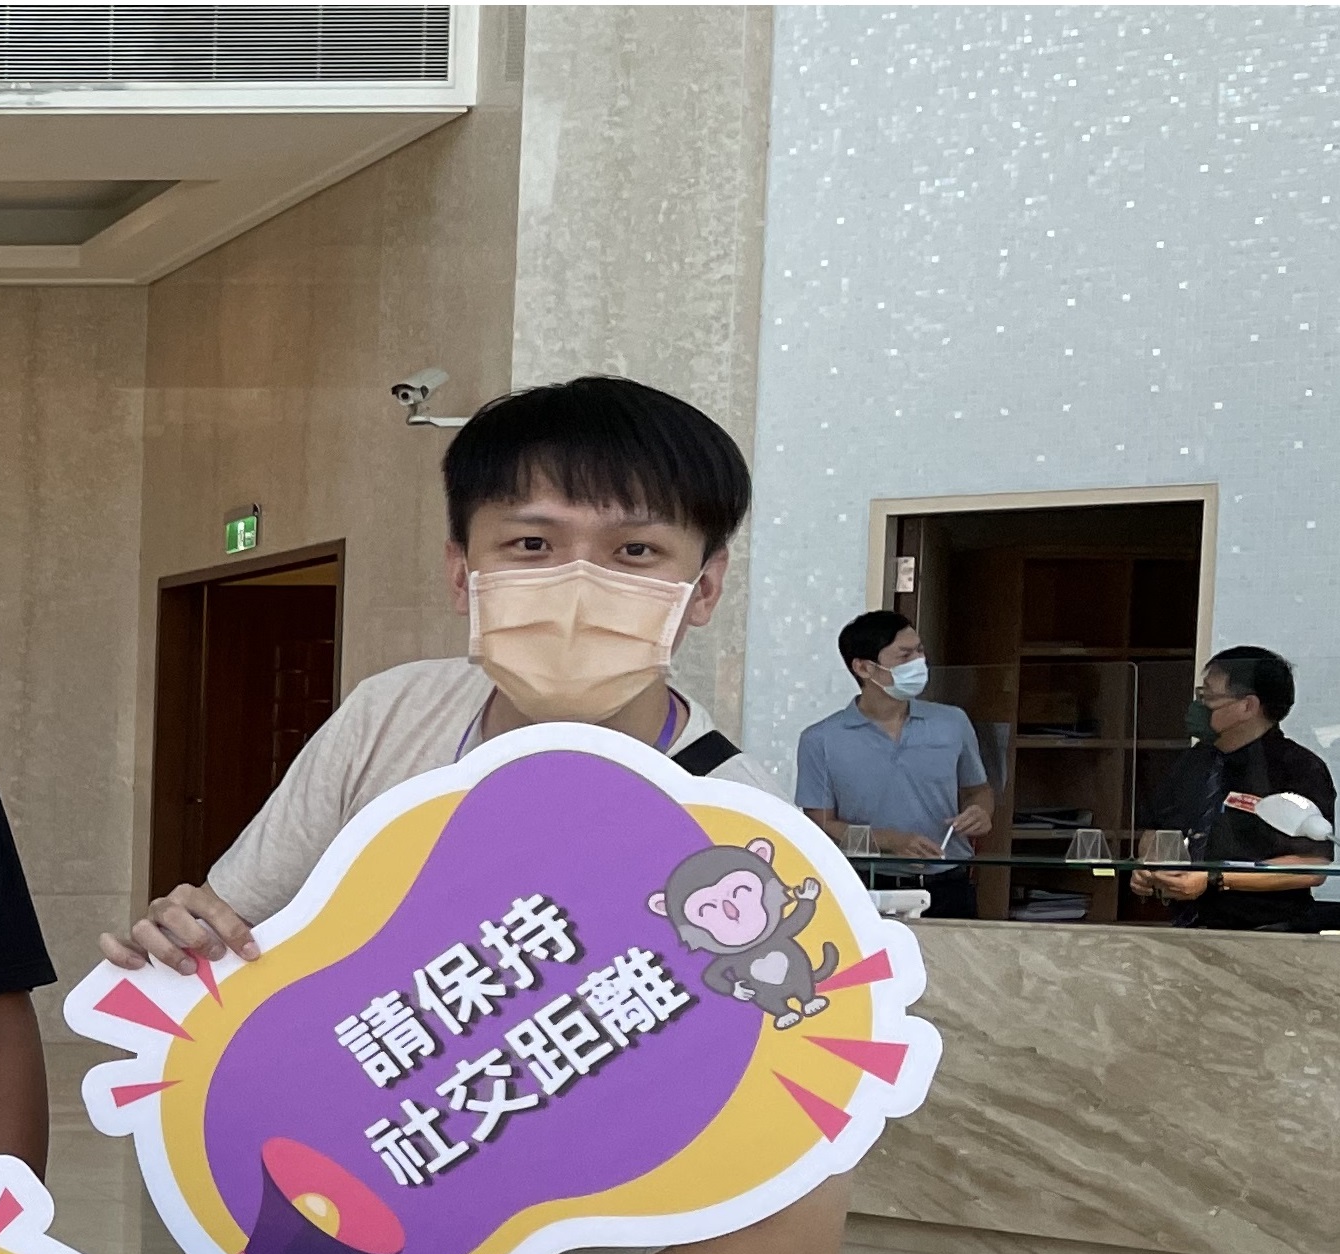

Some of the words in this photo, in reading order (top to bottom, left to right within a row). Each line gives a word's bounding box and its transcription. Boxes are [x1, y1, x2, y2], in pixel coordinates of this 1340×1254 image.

[333, 894, 576, 1089] 請保持
[363, 950, 691, 1186] 社交距離
